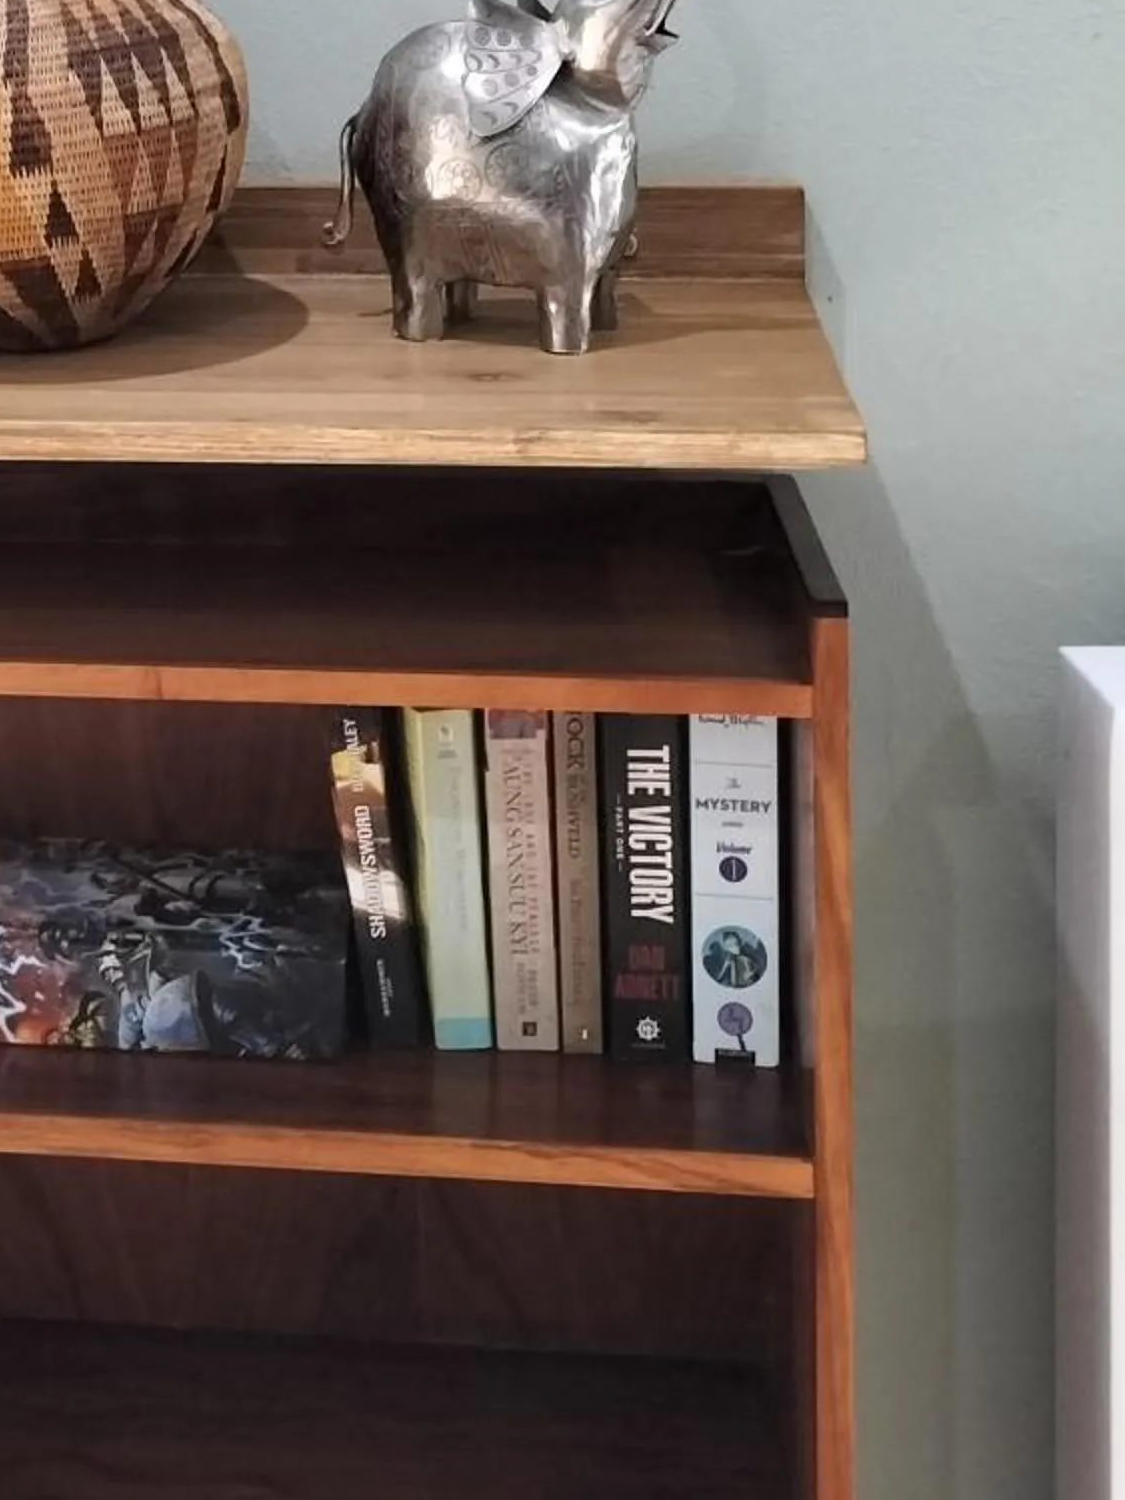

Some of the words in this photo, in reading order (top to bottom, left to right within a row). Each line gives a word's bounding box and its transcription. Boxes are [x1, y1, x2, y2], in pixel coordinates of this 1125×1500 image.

[566, 710, 585, 770] OCK
[503, 765, 524, 822] AUNG
[626, 744, 672, 797] THE
[695, 797, 772, 814] MYSTERY
[354, 804, 387, 939] SHADOWSWORD
[506, 827, 525, 868] SAN
[628, 805, 674, 924] VICTORY
[508, 873, 526, 917] SUU
[510, 921, 529, 955] KYI
